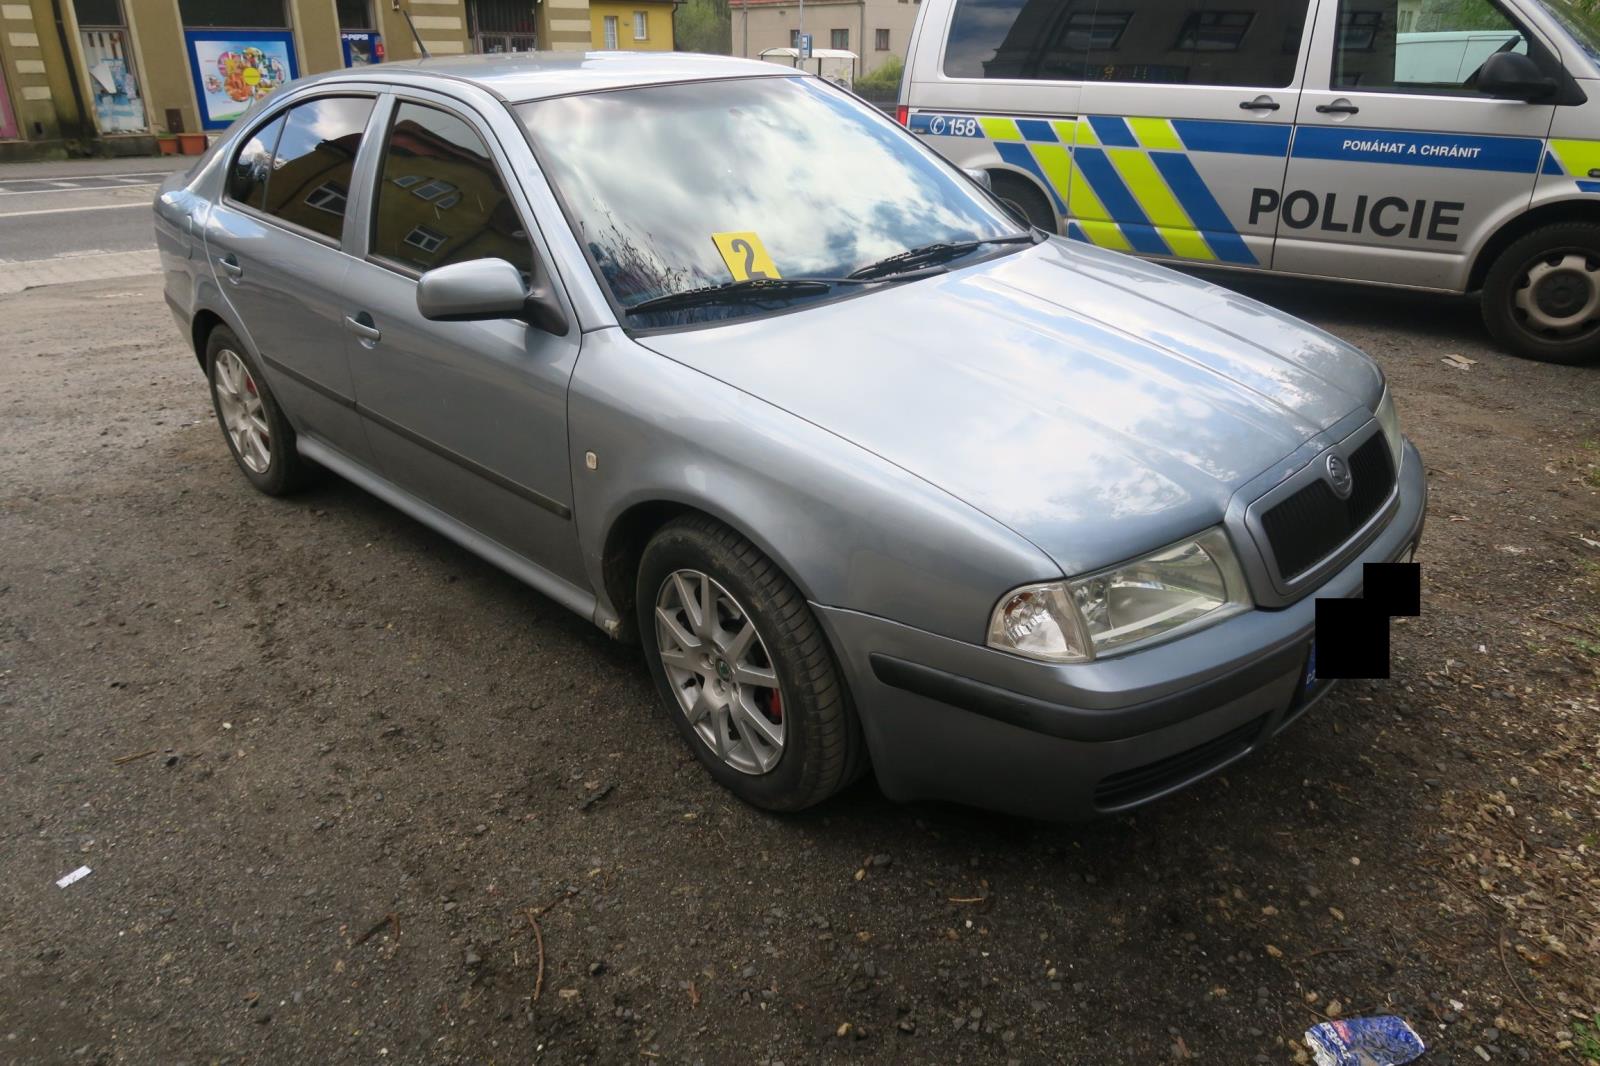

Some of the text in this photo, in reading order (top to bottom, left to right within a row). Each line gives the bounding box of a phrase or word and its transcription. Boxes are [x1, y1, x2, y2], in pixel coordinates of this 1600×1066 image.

[949, 118, 976, 137] 158
[1343, 139, 1481, 158] POMÁHAT A CHRÁNIT
[1248, 188, 1465, 242] POLICIE
[731, 238, 770, 280] 2
